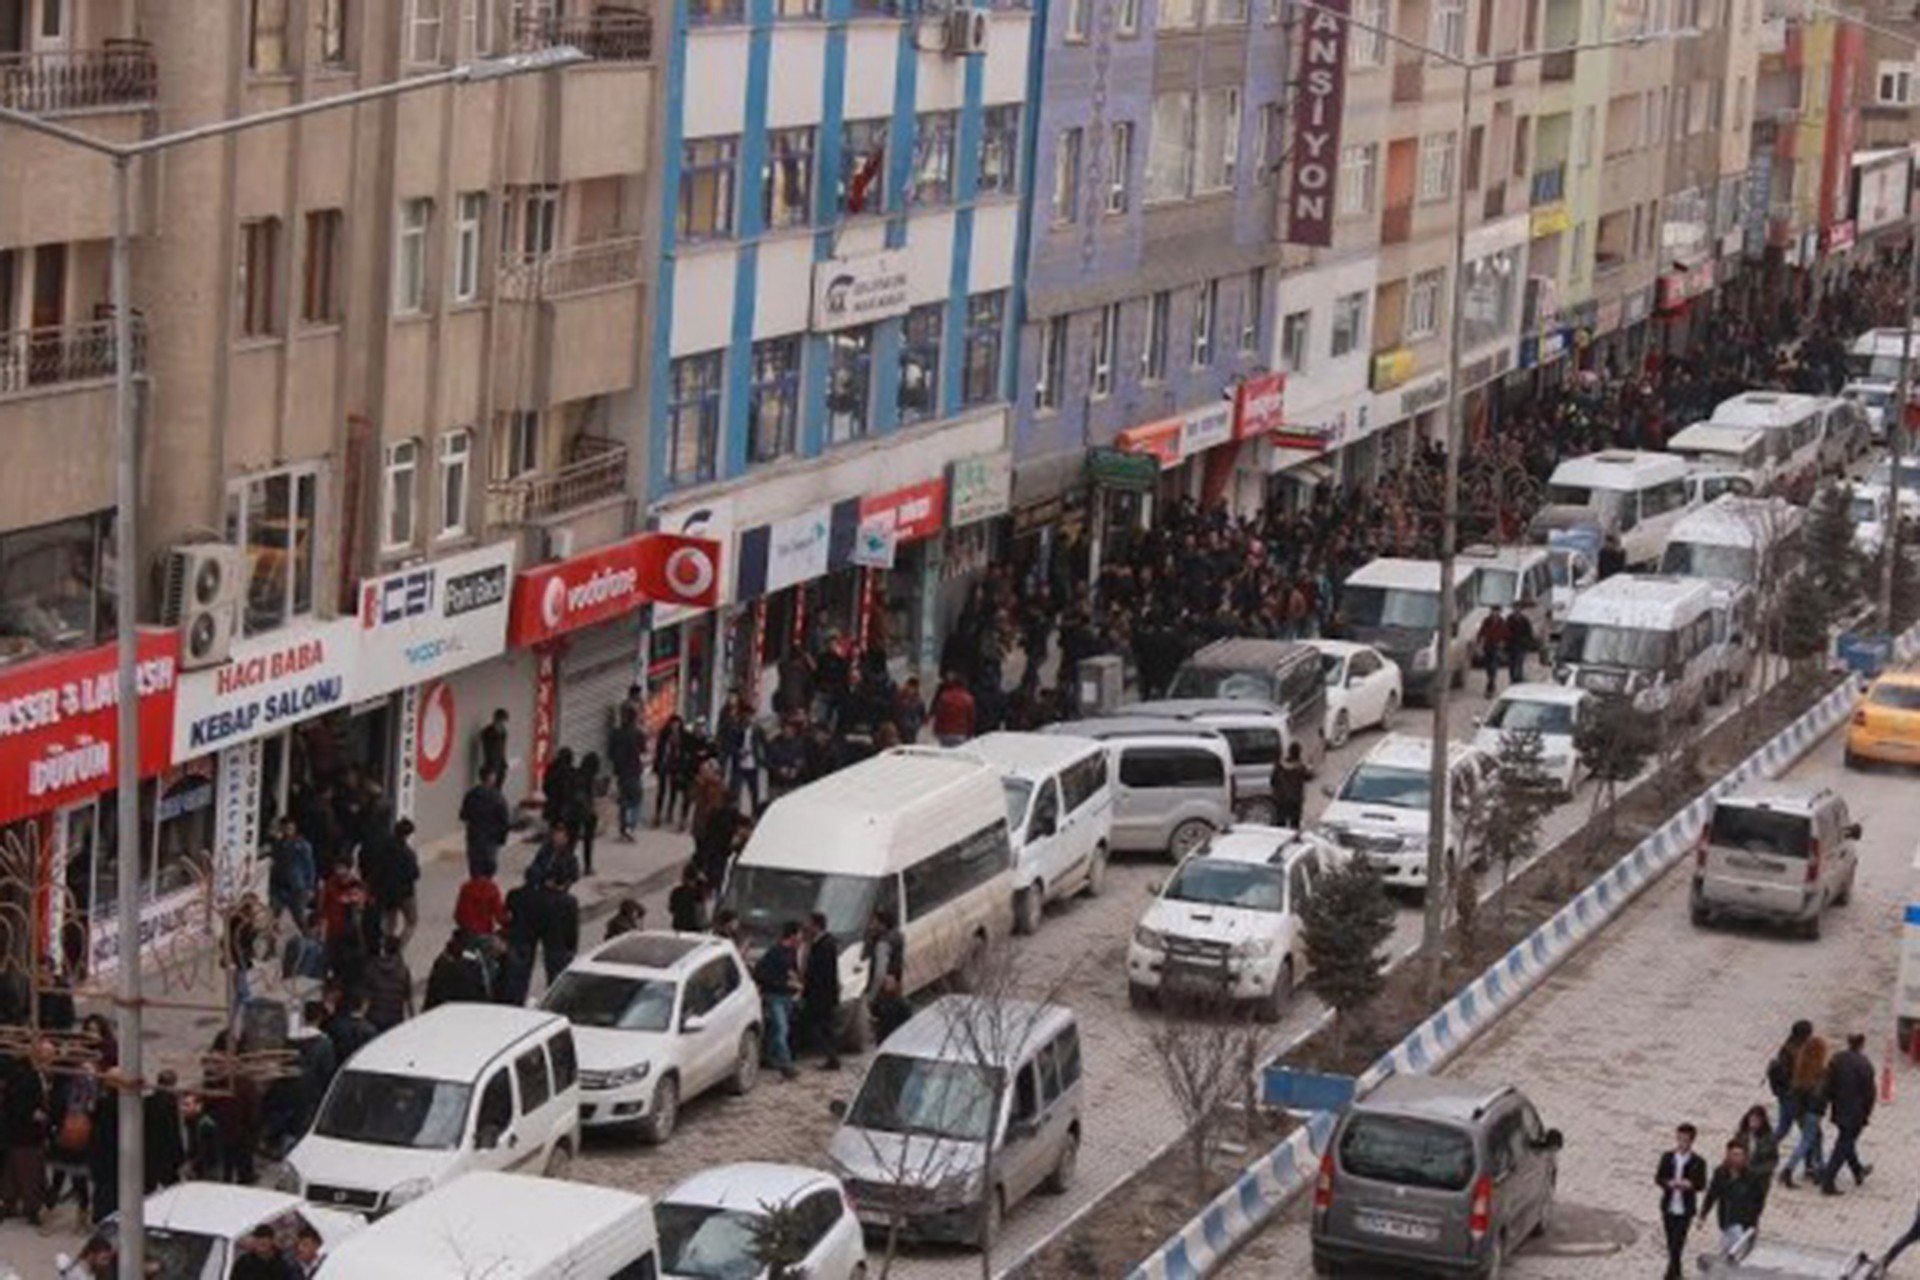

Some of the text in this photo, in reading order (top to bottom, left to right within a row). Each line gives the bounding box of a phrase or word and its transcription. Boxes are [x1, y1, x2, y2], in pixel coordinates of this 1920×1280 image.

[567, 566, 638, 613] vodafone
[216, 639, 324, 696] HACI BABA
[189, 674, 343, 748] KEBAP SALONU
